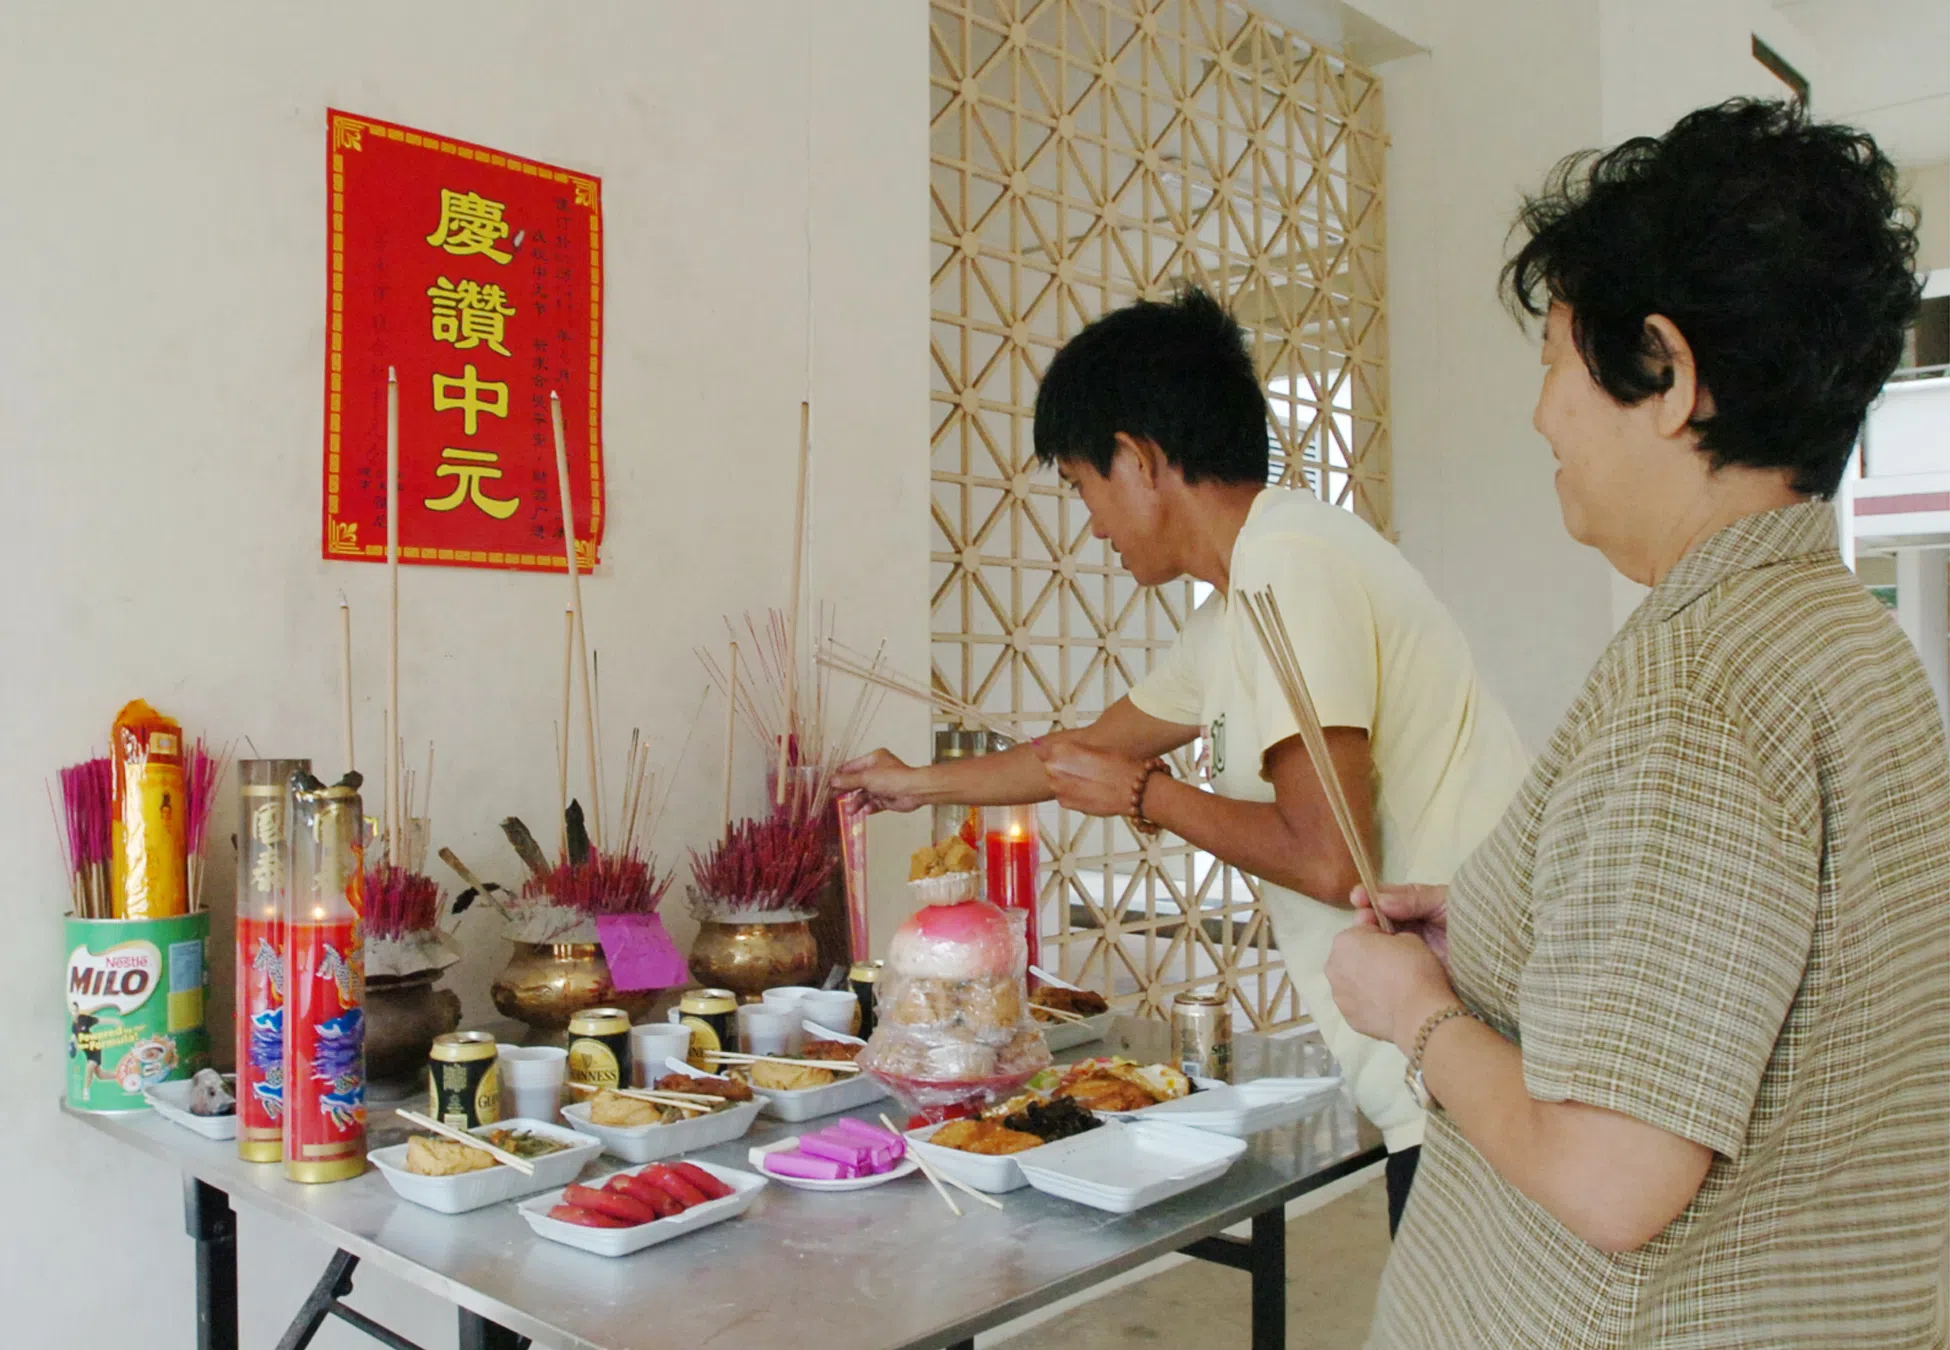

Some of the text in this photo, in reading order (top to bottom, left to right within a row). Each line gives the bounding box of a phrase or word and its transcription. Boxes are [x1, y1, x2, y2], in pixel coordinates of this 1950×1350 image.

[424, 188, 520, 519] 慶讚中元
[69, 965, 149, 996] MILO
